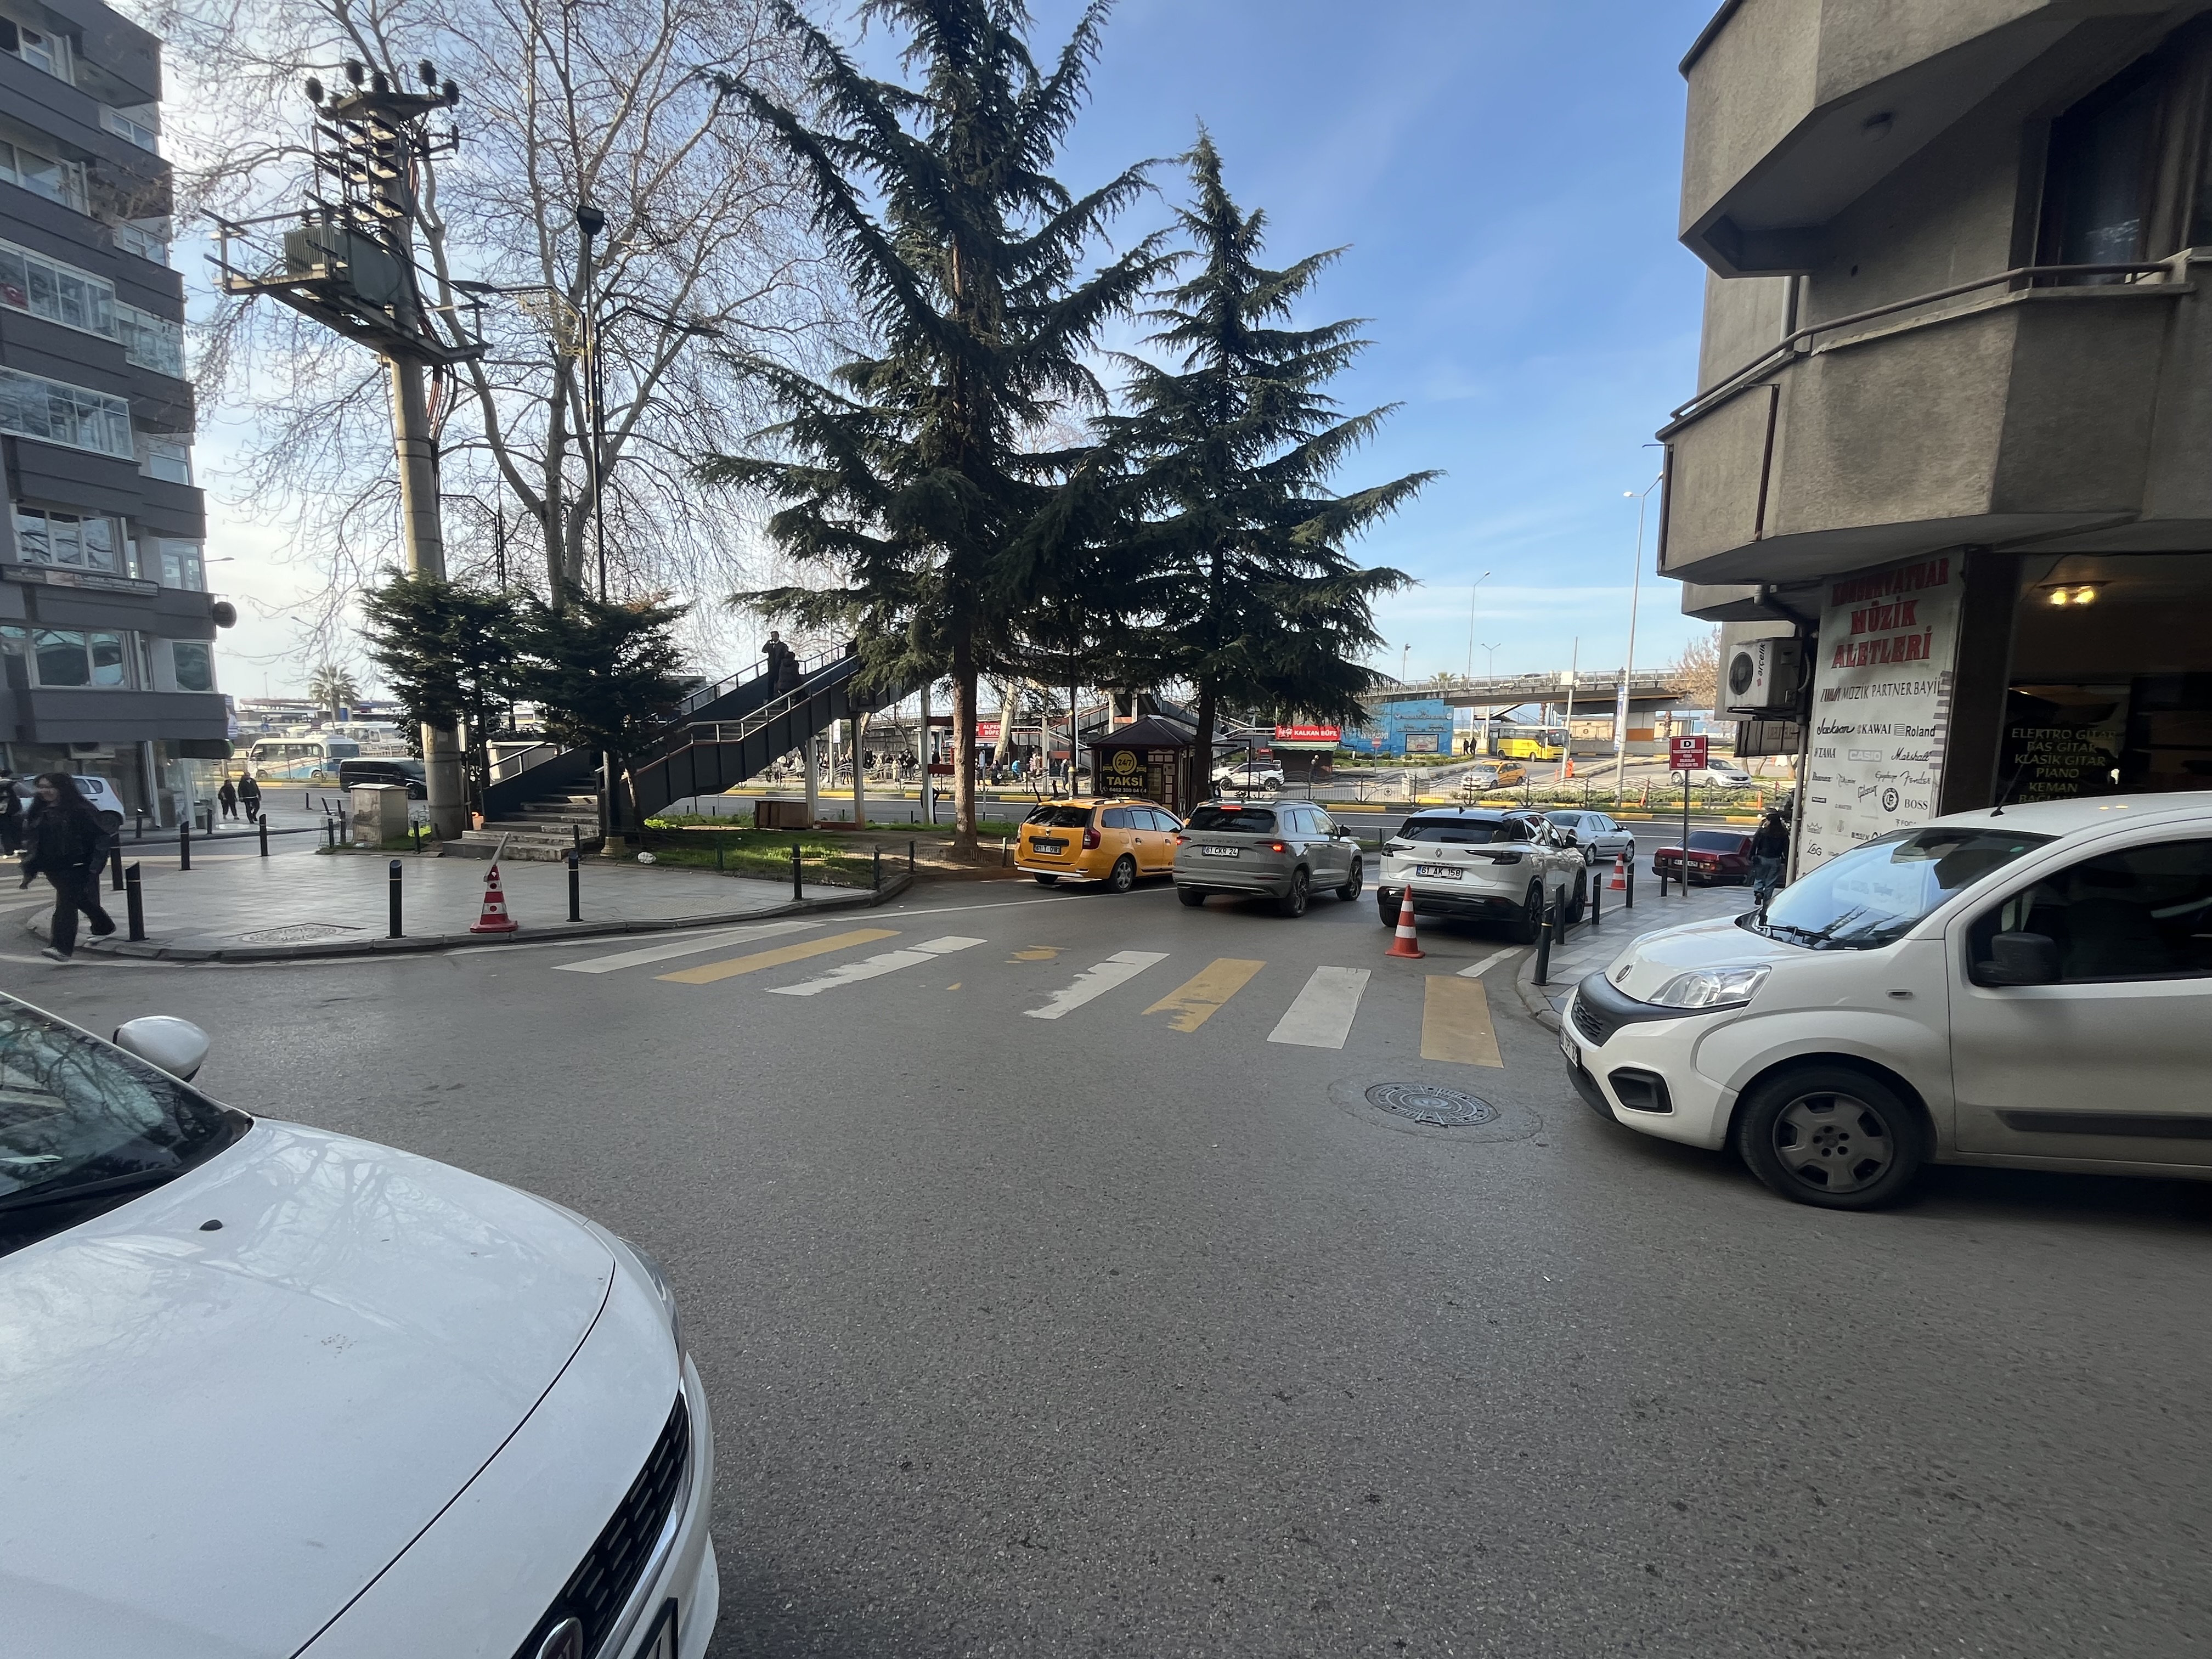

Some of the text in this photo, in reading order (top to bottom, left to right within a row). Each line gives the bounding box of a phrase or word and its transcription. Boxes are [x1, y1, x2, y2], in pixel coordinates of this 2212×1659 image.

[1850, 596, 1920, 635] MÜZİK
[1831, 625, 1932, 669] ALETLERİ
[1871, 682, 1914, 697] PARTNER
[1861, 724, 1891, 735] KAWAI
[1905, 725, 1936, 737] Roland
[2012, 728, 2072, 740] ELEKTRO
[2027, 741, 2052, 752] BAS
[1849, 751, 1882, 761] CASIO
[1891, 747, 1930, 761] Marshall
[1107, 775, 1143, 786] TAKSİ
[2029, 782, 2078, 793] KEMAN
[1904, 799, 1928, 810] BOSS
[1448, 868, 1460, 877] 158
